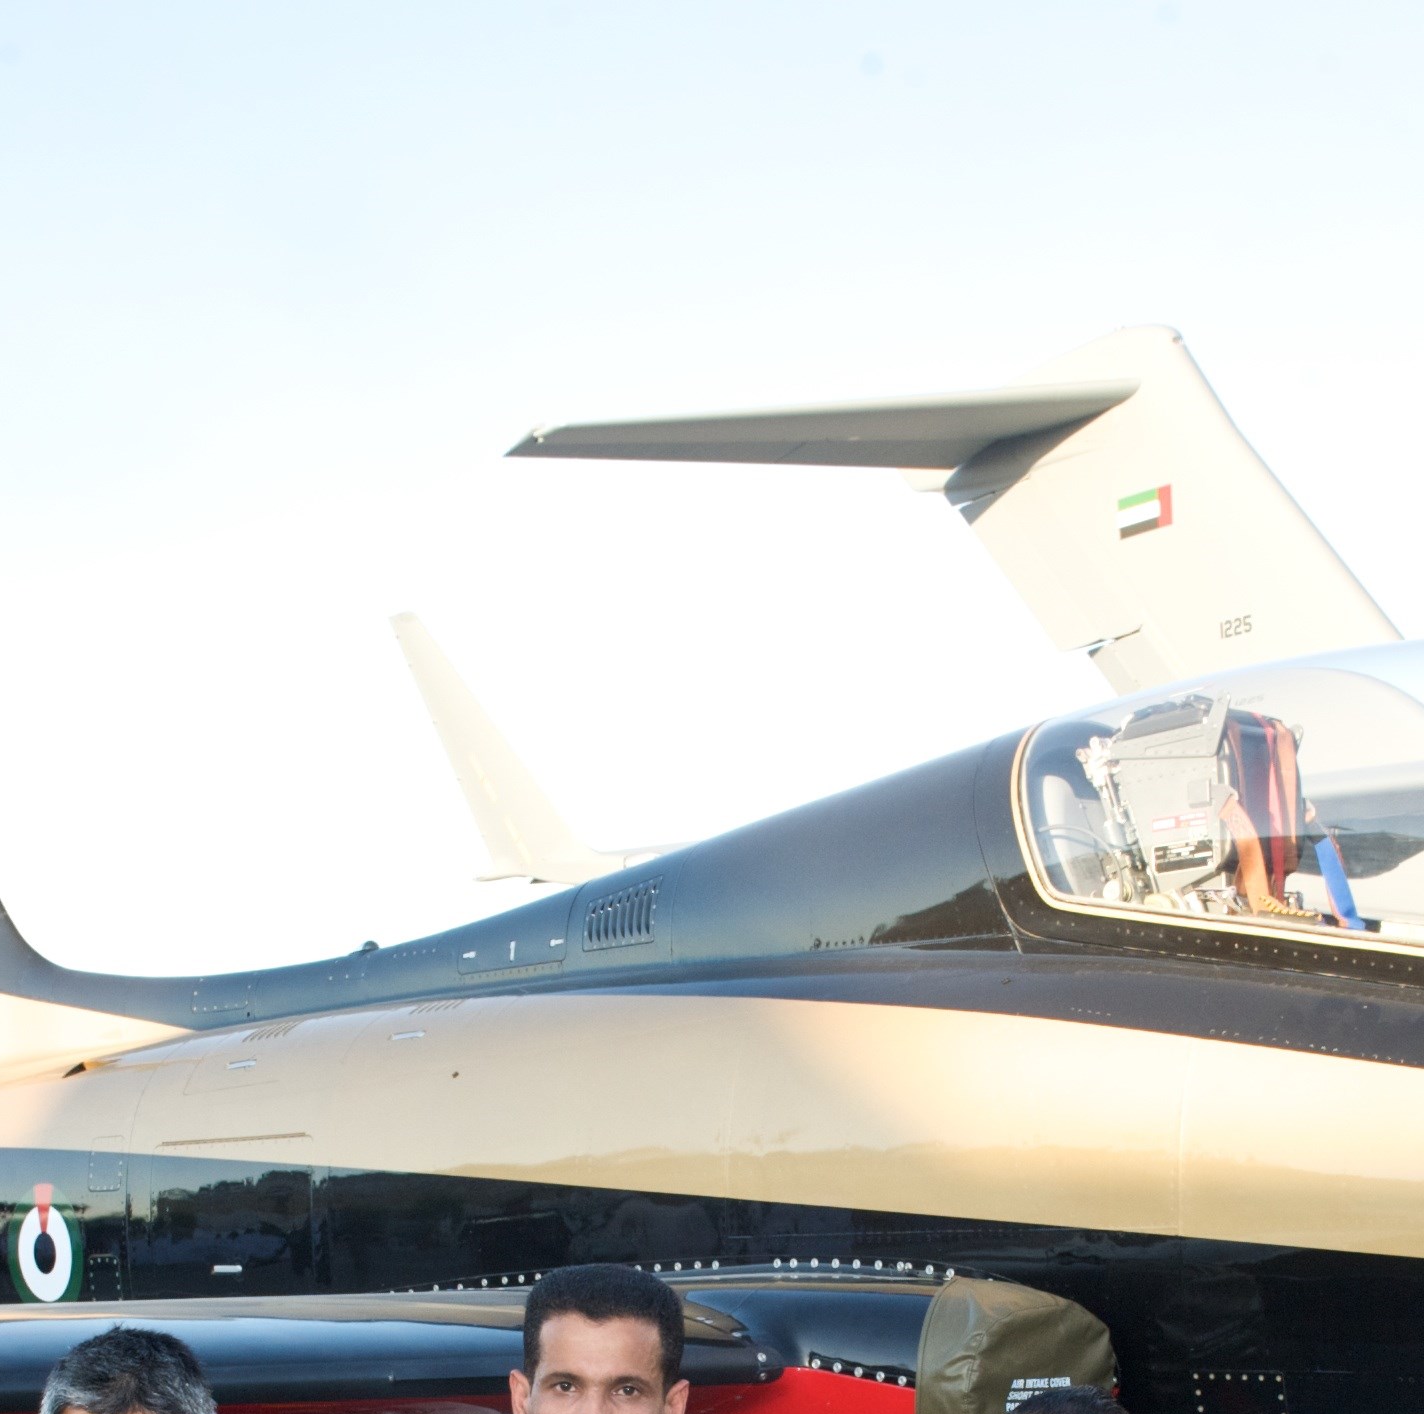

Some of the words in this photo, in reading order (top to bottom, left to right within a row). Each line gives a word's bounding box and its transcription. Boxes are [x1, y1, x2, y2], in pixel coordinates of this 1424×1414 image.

[1220, 614, 1252, 639] 1225
[1011, 1379, 1025, 1389] AIR
[1025, 1378, 1049, 1388] INTAKE
[1049, 1377, 1072, 1387] COVER
